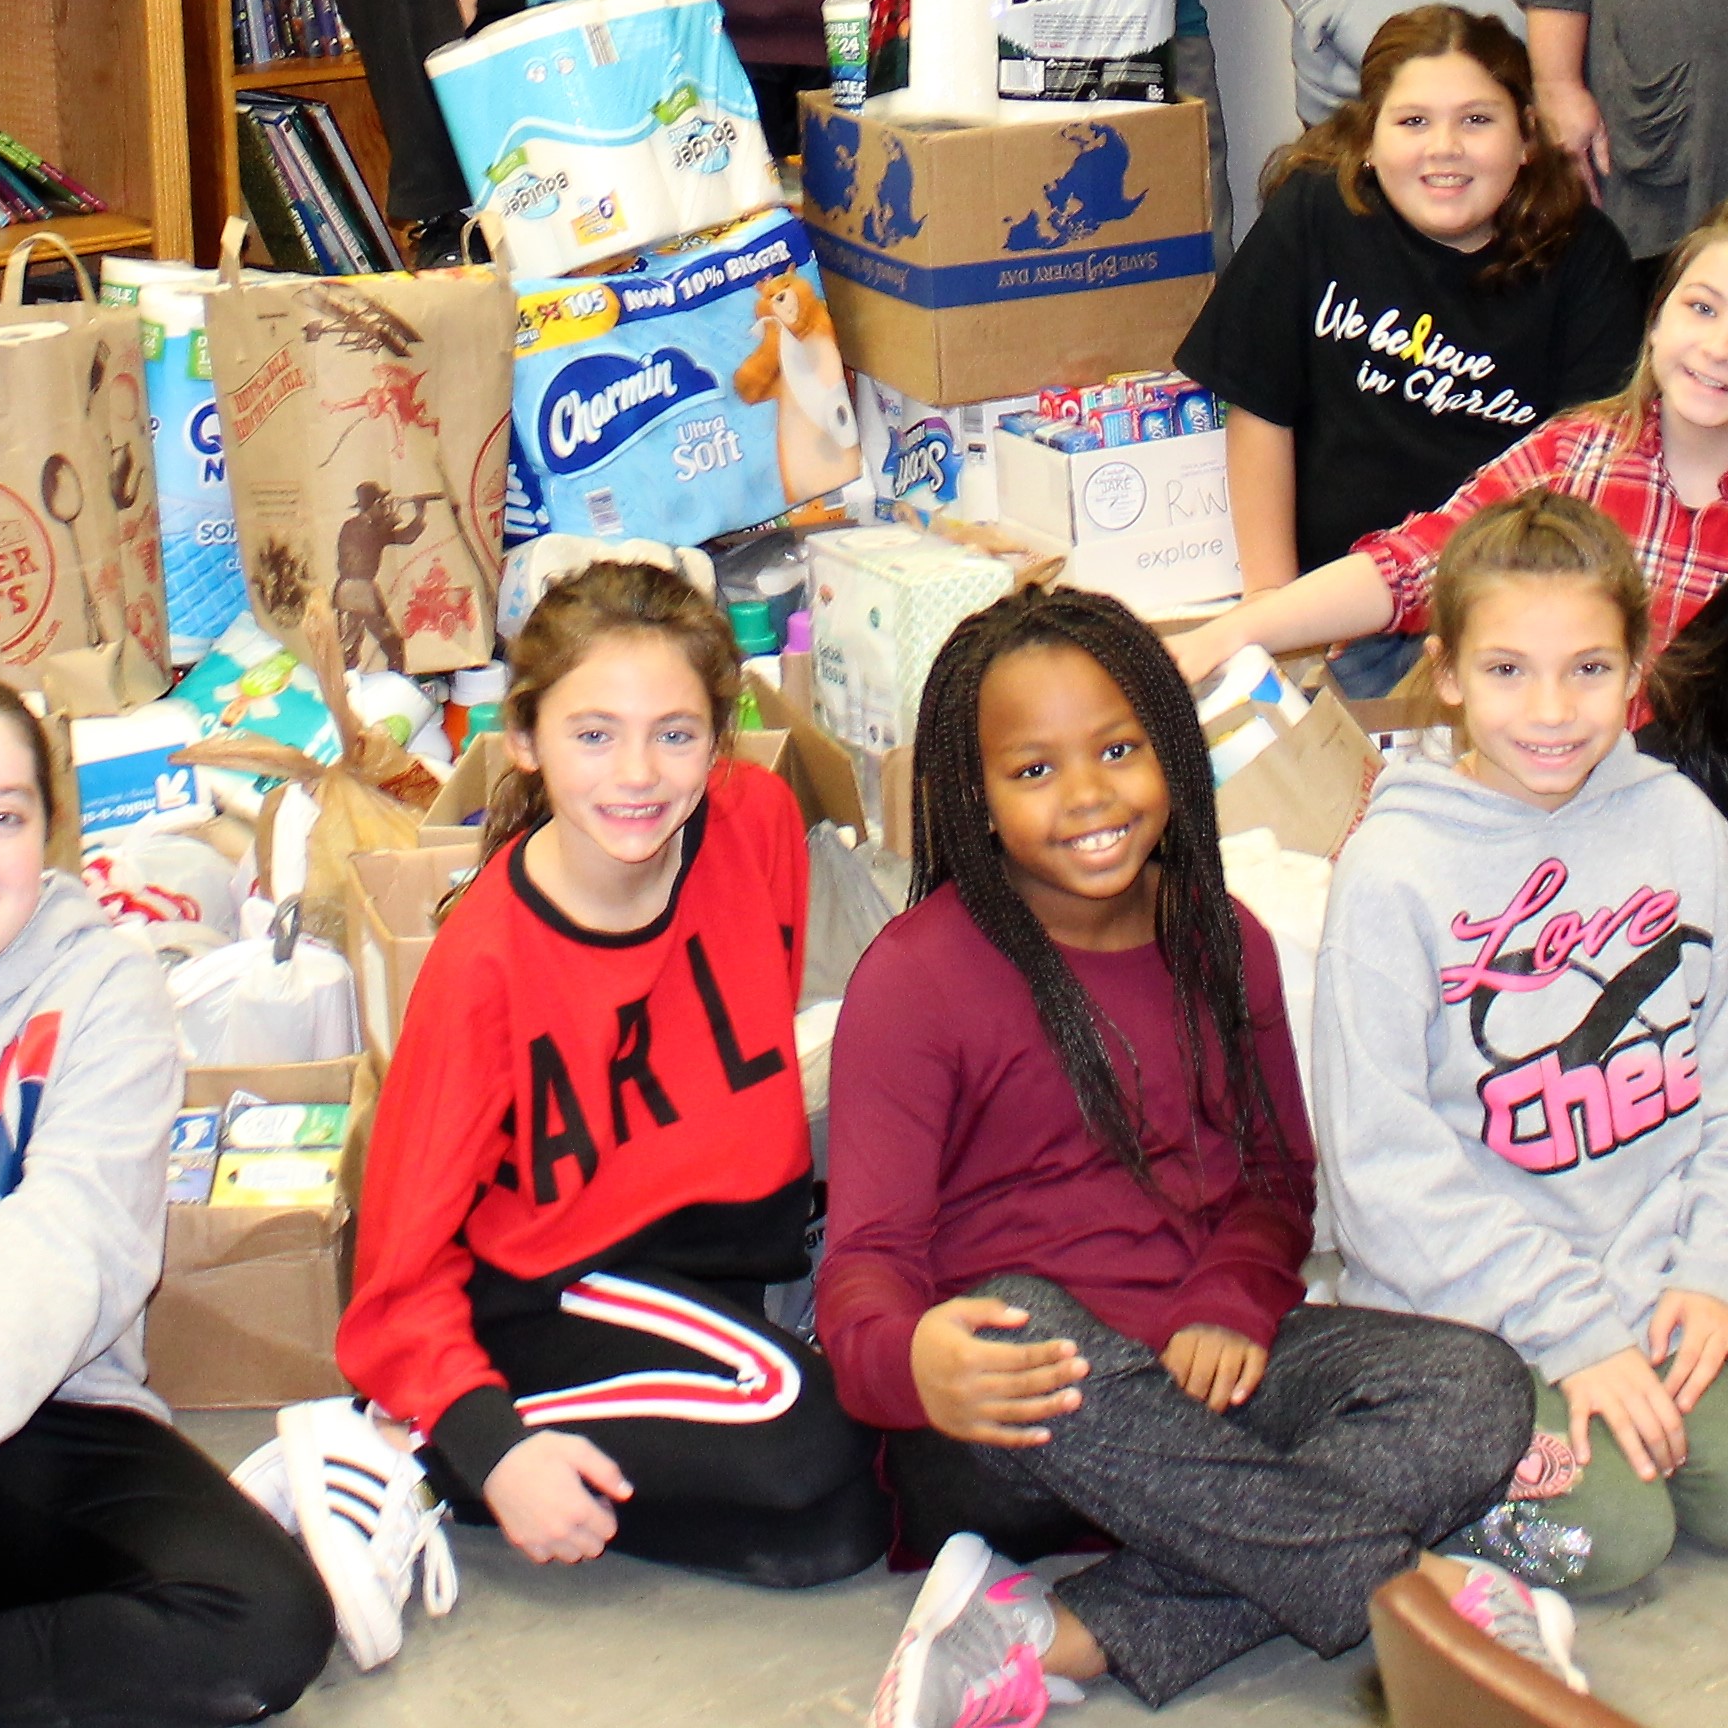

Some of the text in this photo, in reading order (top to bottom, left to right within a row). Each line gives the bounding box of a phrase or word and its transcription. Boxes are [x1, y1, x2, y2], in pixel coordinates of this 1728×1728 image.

[500, 171, 570, 218] Boulder
[623, 279, 677, 313] NOW
[678, 264, 725, 300] 10%
[724, 241, 793, 283] BIGGER
[995, 268, 1031, 290] DAY
[1032, 259, 1086, 283] EVERY
[564, 288, 608, 318] 105
[1314, 280, 1496, 380] We believe
[548, 352, 678, 459] Charmin
[1355, 359, 1537, 426] in Charlie
[677, 415, 725, 442] Ultra
[671, 429, 745, 482] Soft
[1137, 536, 1225, 574] explore
[1440, 857, 1682, 1005] Love
